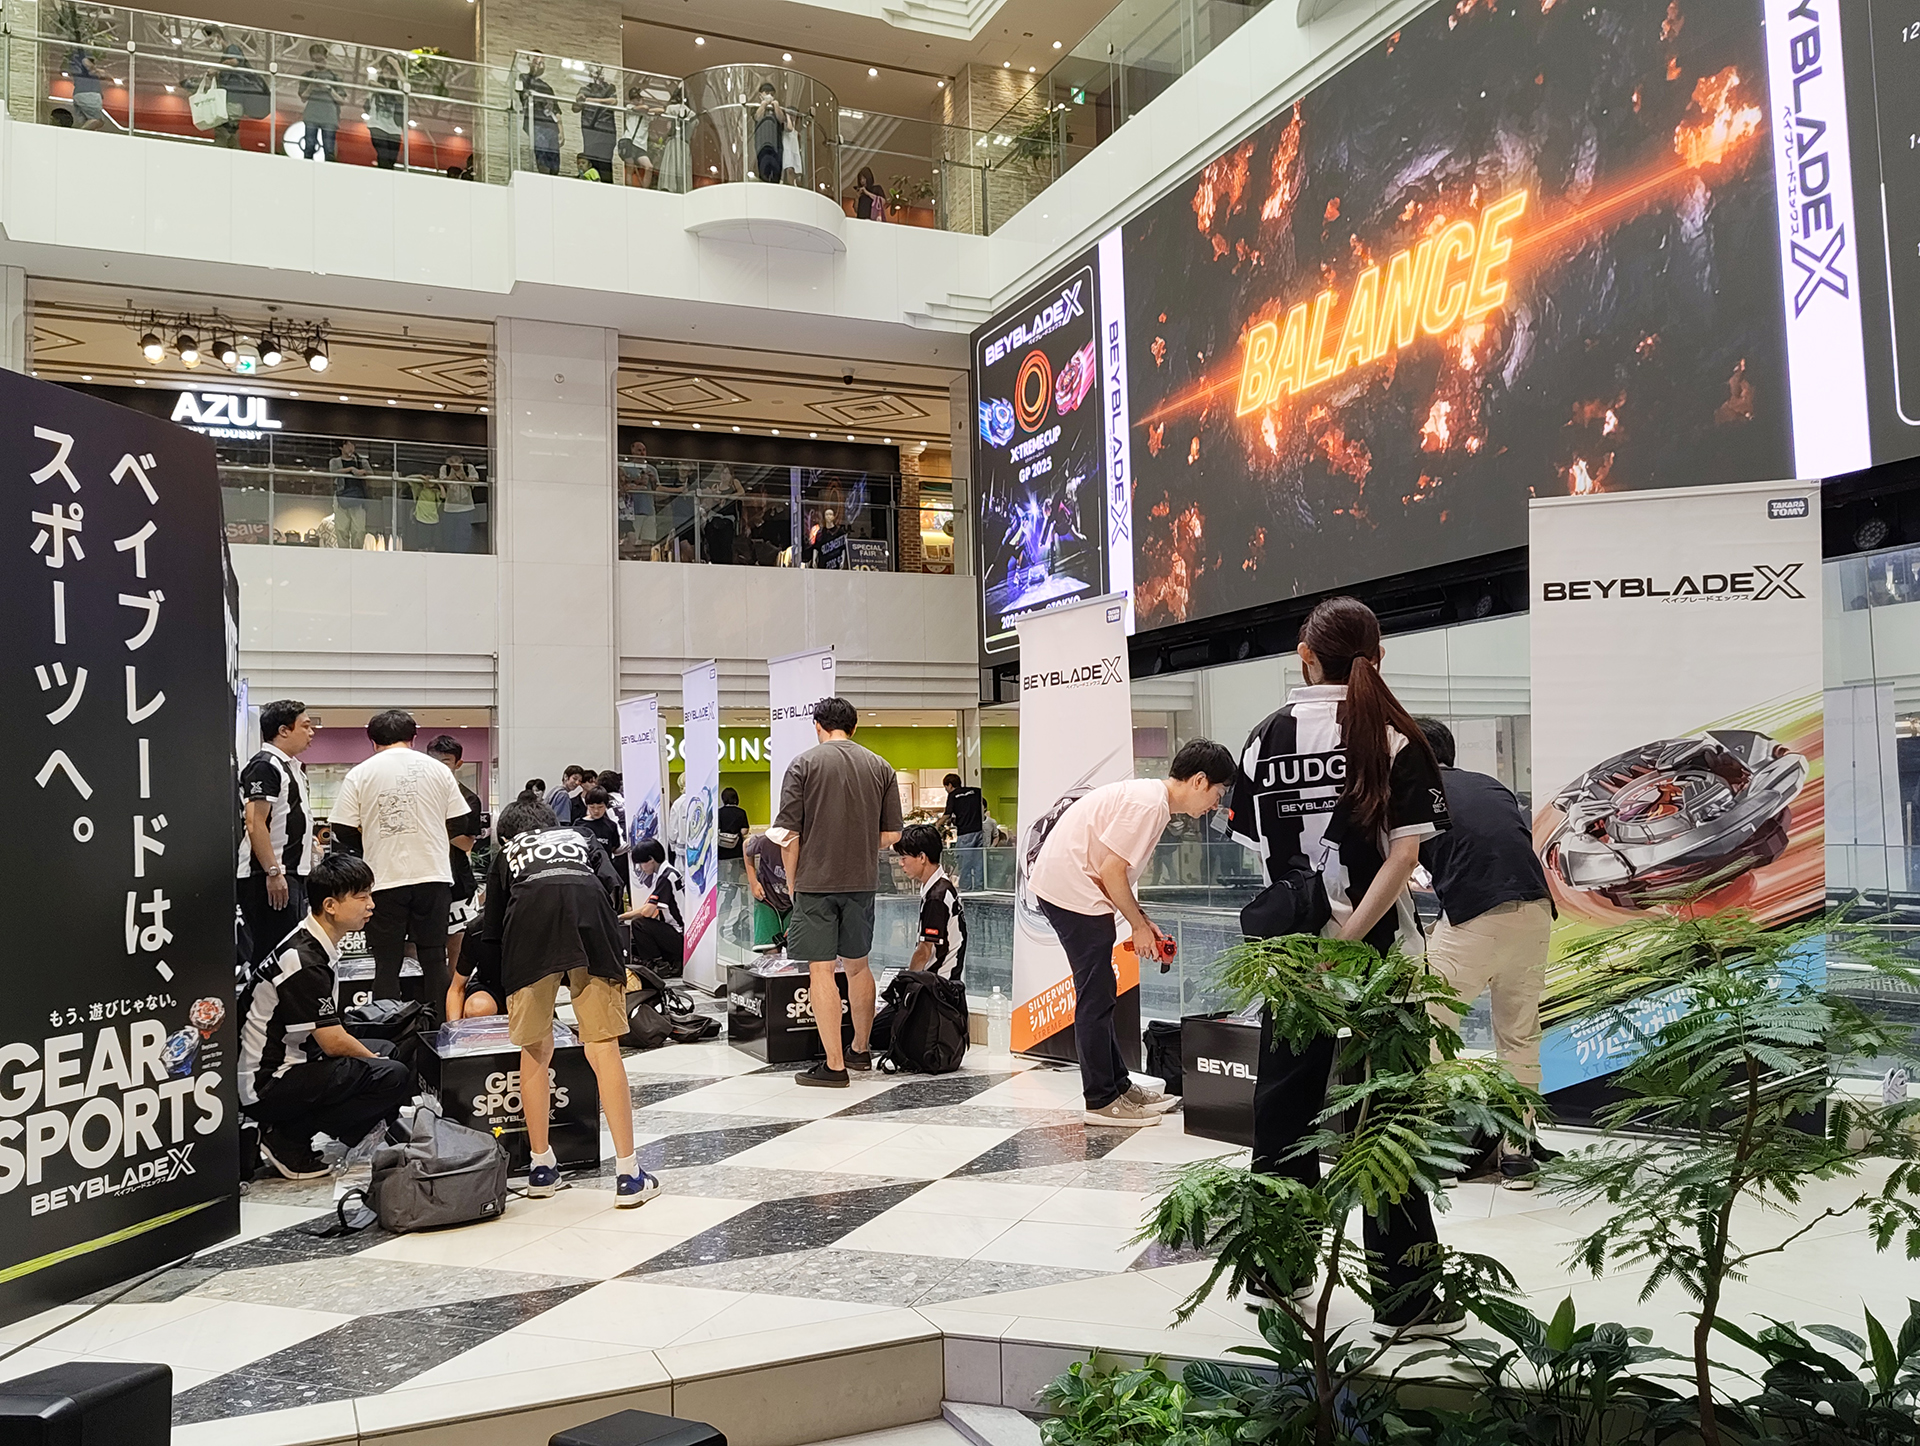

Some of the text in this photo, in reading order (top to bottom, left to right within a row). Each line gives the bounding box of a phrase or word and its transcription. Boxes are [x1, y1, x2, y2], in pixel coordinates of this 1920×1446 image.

[1236, 189, 1528, 418] BALANCE
[170, 391, 283, 429] AZUL
[1044, 424, 1061, 447] CUP
[1018, 465, 1032, 483] GP
[1031, 455, 1053, 478] 2025
[1771, 500, 1806, 510] TAKARA
[1771, 508, 1805, 517] TOMY
[852, 543, 882, 551] SPECIAL
[1661, 594, 1750, 604] ベイブレードエックス
[29, 425, 95, 843] スポーツへ。
[109, 453, 175, 982] ベイブレードは、
[1262, 755, 1347, 787] JUDG
[1281, 800, 1338, 813] BEYBLAD
[509, 842, 588, 878] SHOOT
[49, 993, 177, 1028] もう、遊びじゃない。
[0, 1019, 169, 1118] GEAR
[485, 1067, 557, 1094] GER
[1197, 1056, 1258, 1080] BEYBL
[0, 1071, 225, 1195] SPORTS
